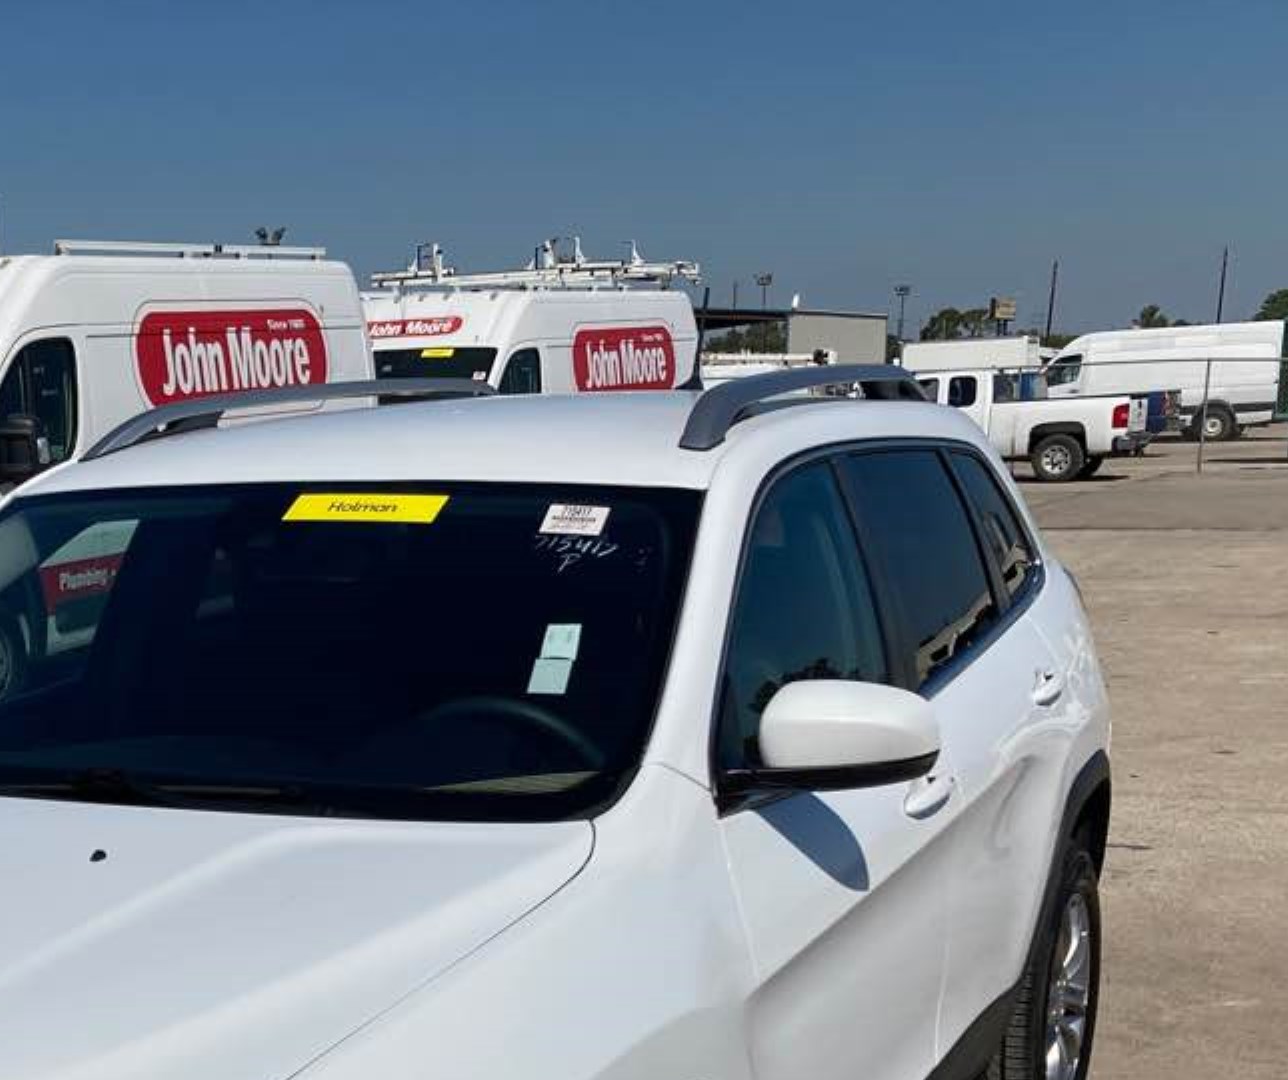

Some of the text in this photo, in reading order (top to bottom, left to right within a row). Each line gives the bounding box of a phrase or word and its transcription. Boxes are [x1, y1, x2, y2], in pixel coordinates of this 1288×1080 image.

[369, 322, 402, 337] John
[406, 319, 453, 334] Moore
[162, 326, 311, 396] John Moore
[585, 339, 667, 389] John Moore
[327, 501, 399, 513] Holman
